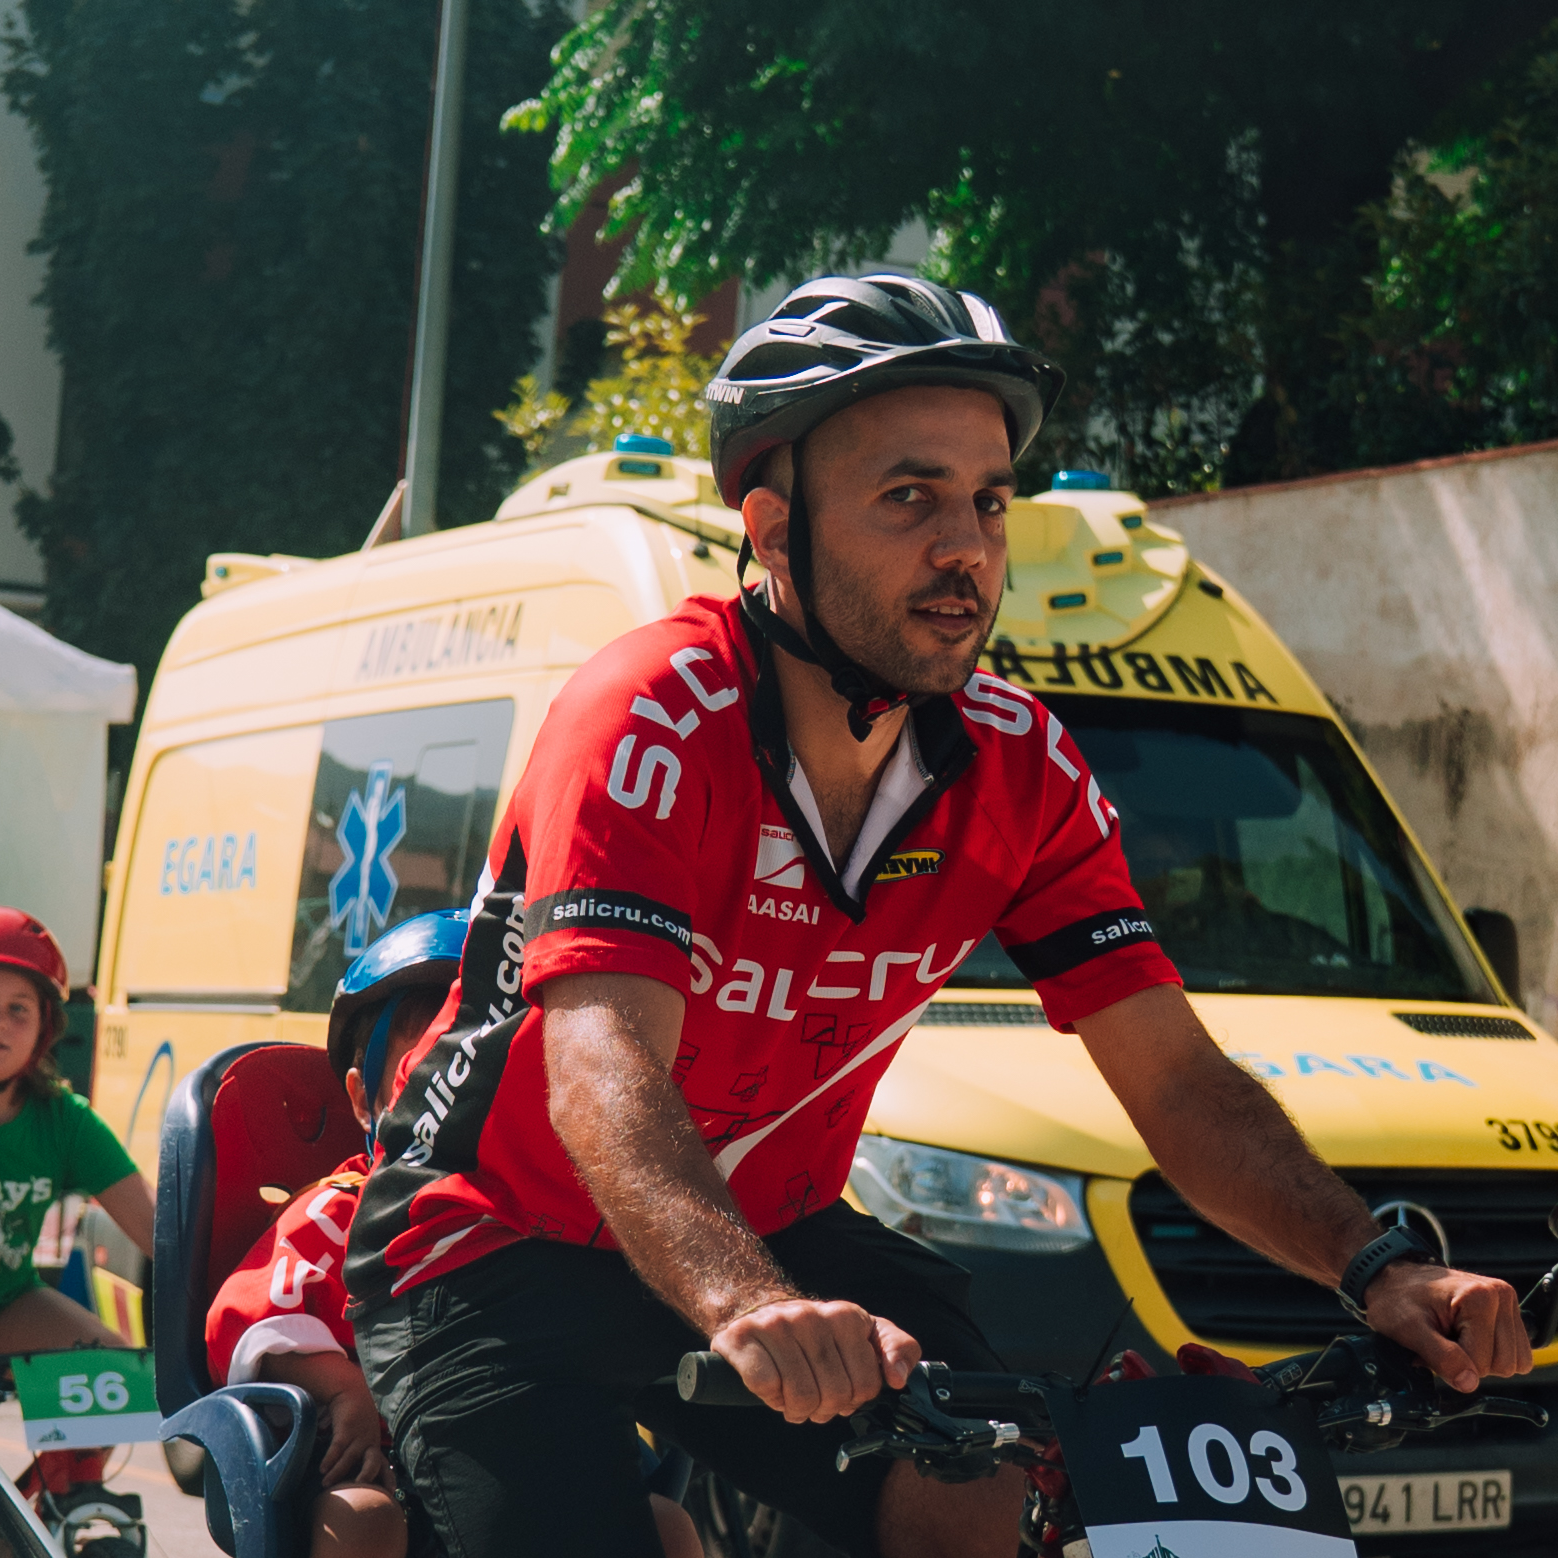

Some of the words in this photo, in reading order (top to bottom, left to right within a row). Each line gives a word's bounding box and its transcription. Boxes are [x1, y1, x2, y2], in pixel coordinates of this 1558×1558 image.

[606, 646, 740, 821] SLC
[160, 831, 257, 895] EGARA
[552, 899, 692, 947] salicru.com
[1228, 1051, 1480, 1089] GARA
[57, 1370, 130, 1414] 56
[1120, 1421, 1308, 1513] 103
[1342, 1481, 1414, 1525] 941
[1432, 1478, 1503, 1522] LRR
